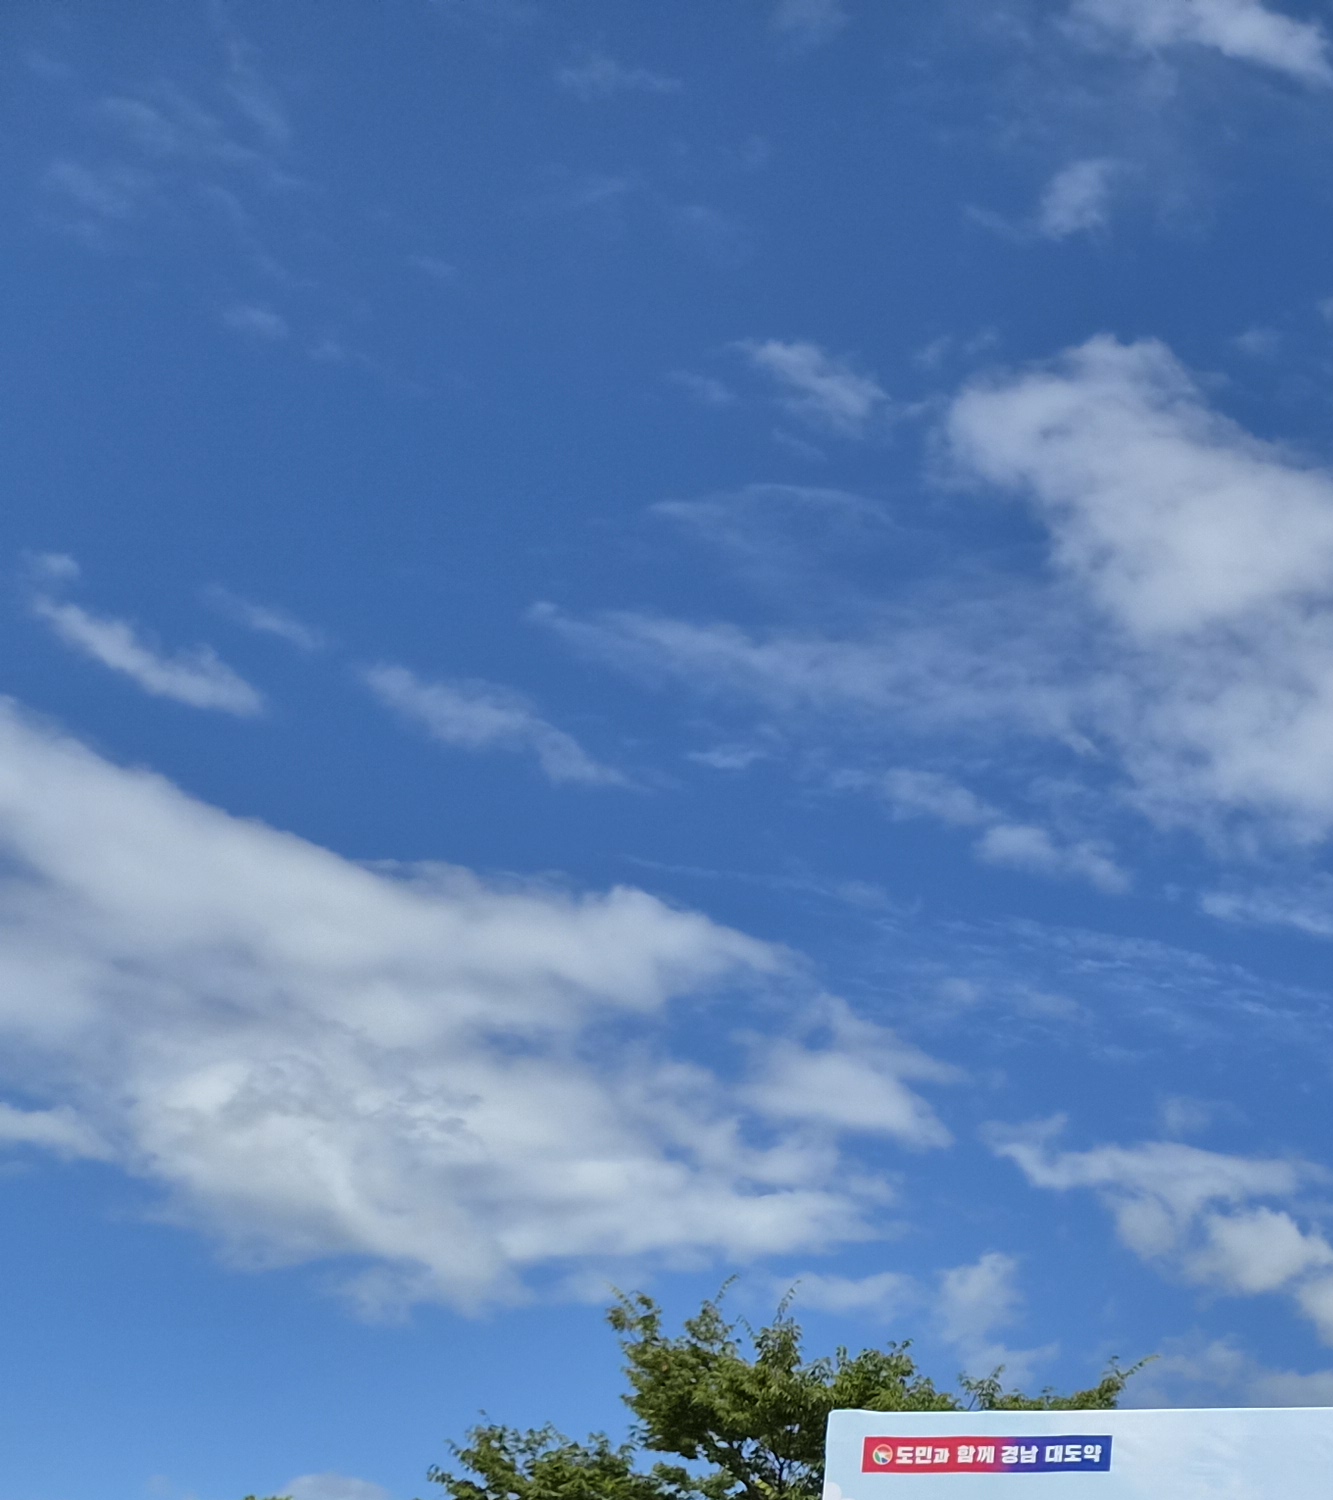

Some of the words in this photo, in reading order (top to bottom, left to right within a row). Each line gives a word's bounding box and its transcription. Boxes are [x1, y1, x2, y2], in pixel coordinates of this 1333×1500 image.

[896, 1446, 950, 1464] 도민과
[957, 1445, 995, 1464] 함께
[1001, 1445, 1038, 1464] 경남
[1045, 1444, 1101, 1463] 대도약
